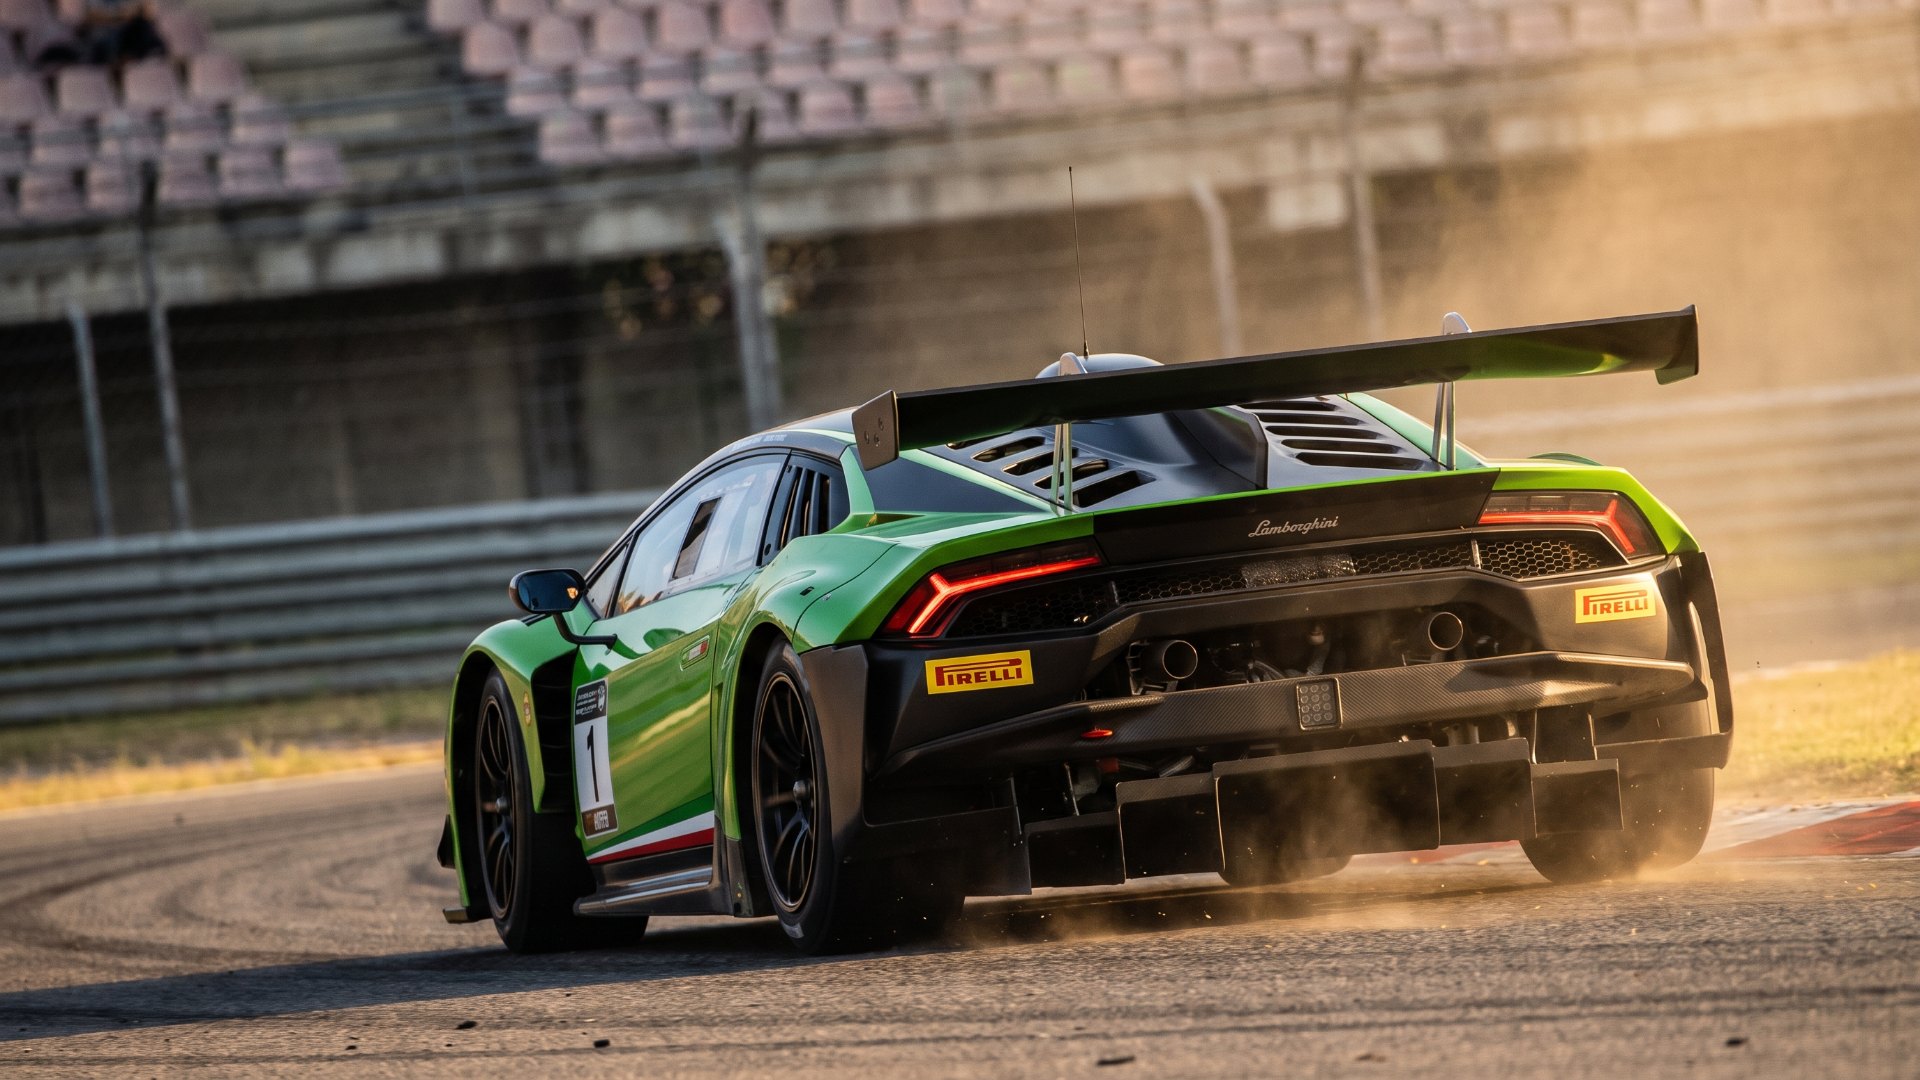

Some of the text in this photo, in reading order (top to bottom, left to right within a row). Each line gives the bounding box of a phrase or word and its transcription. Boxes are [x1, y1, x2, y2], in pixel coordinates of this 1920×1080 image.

[1248, 516, 1338, 537] Lamborghini
[1583, 590, 1648, 615] PIRELLI
[935, 658, 1022, 687] PIRELLI
[587, 725, 599, 802] 1
